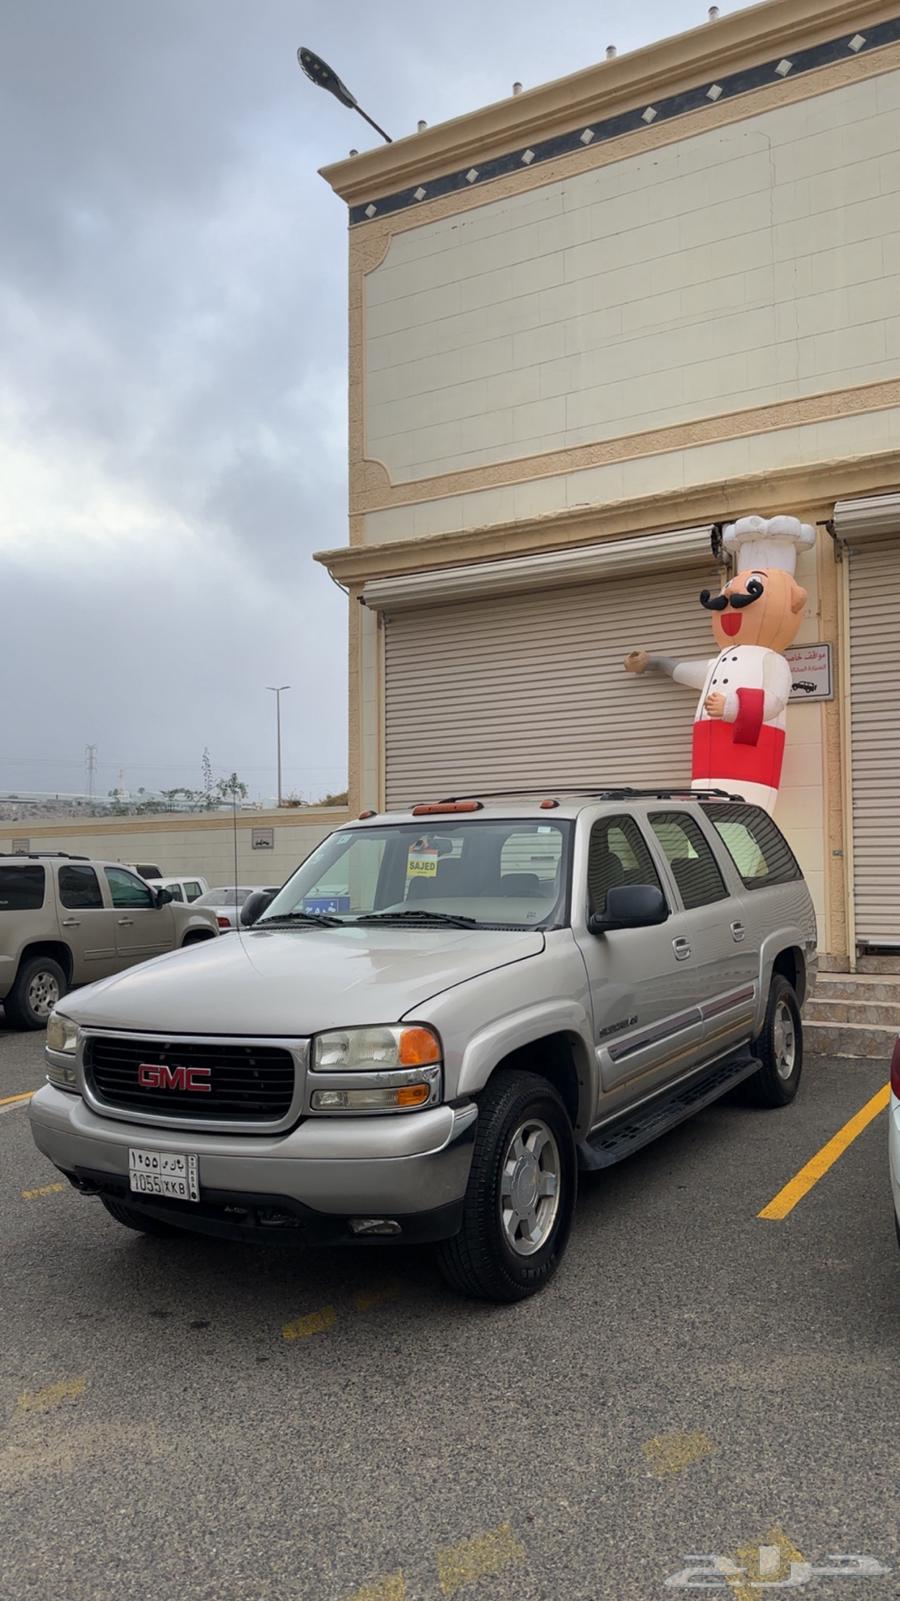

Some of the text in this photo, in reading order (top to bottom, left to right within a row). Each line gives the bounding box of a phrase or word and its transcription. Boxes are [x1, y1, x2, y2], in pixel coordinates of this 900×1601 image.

[409, 861, 436, 871] SAJED
[139, 1063, 211, 1092] GMC
[132, 1173, 185, 1195] 1055 XKB
